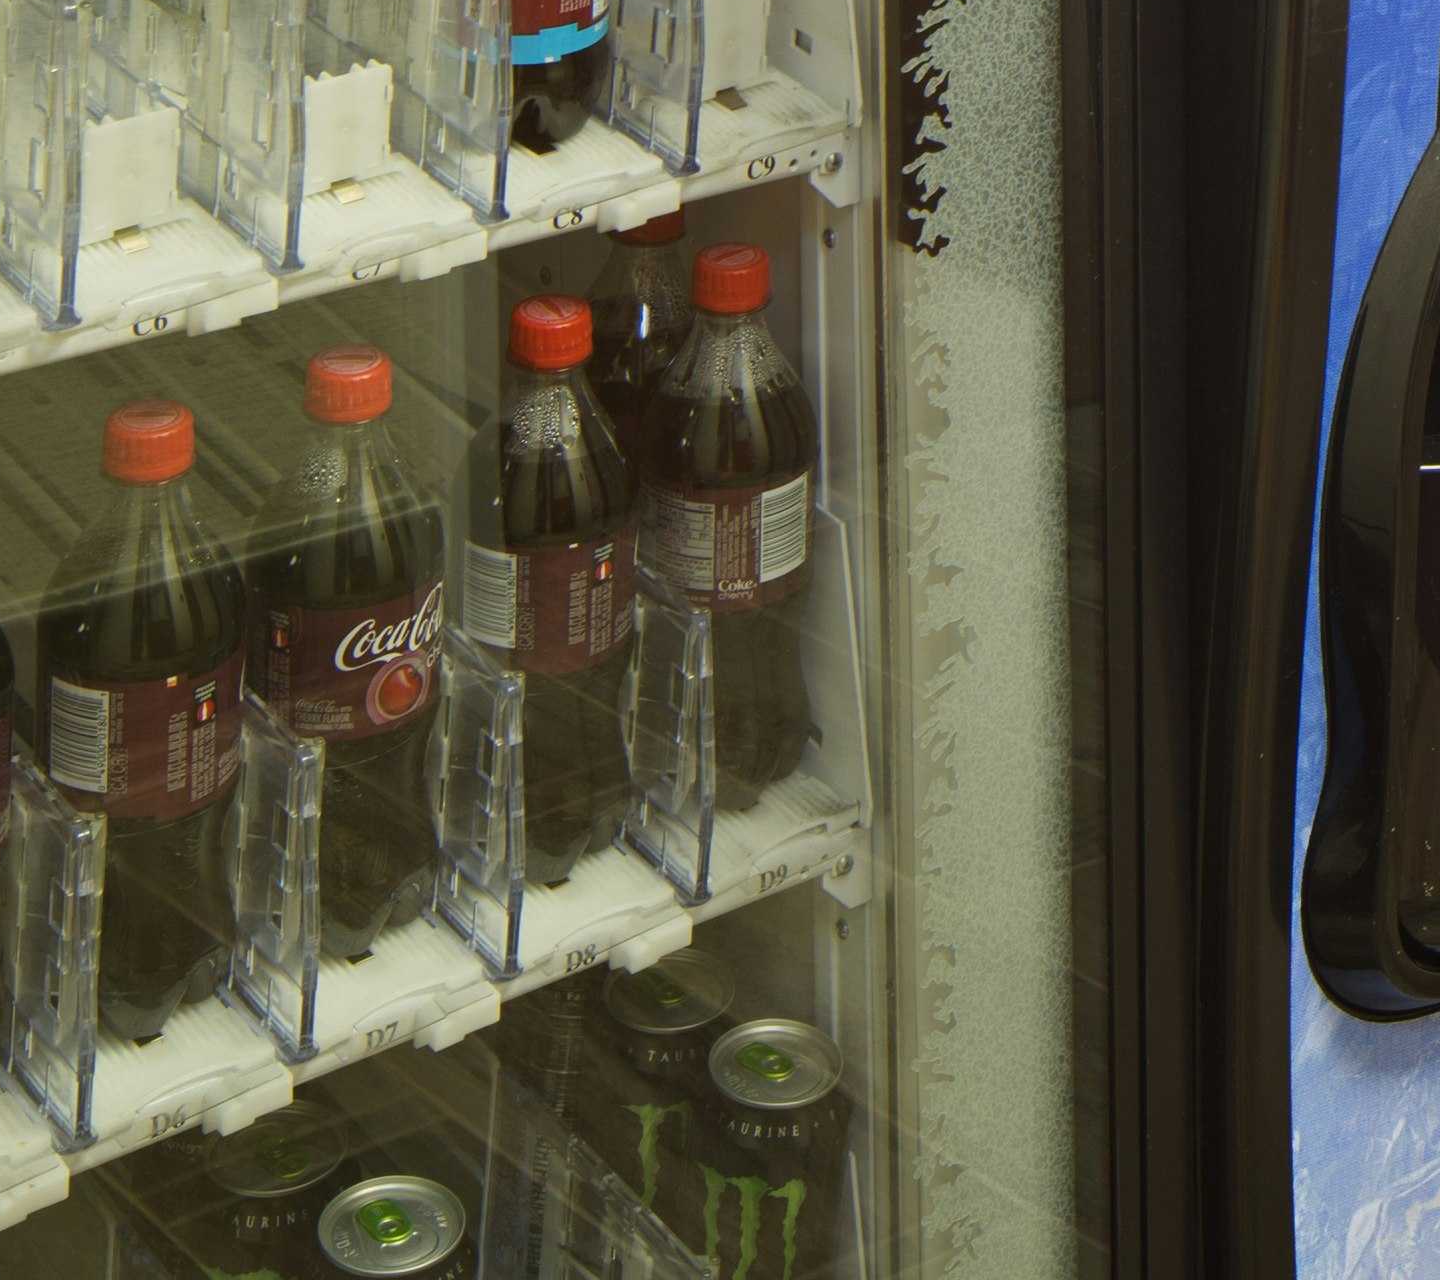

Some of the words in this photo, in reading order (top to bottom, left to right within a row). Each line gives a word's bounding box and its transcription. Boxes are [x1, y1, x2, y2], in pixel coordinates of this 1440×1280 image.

[746, 155, 776, 180] C9
[553, 208, 583, 230] C8
[132, 311, 168, 338] C6
[718, 579, 753, 591] Coke
[718, 591, 753, 600] cherry
[295, 712, 321, 723] CHERRY
[323, 713, 350, 722] FLAVOR
[759, 863, 789, 893] D9
[564, 943, 596, 976] D8
[364, 1019, 400, 1053] D7
[150, 1109, 186, 1142] D6
[717, 1111, 801, 1138] TAURINE
